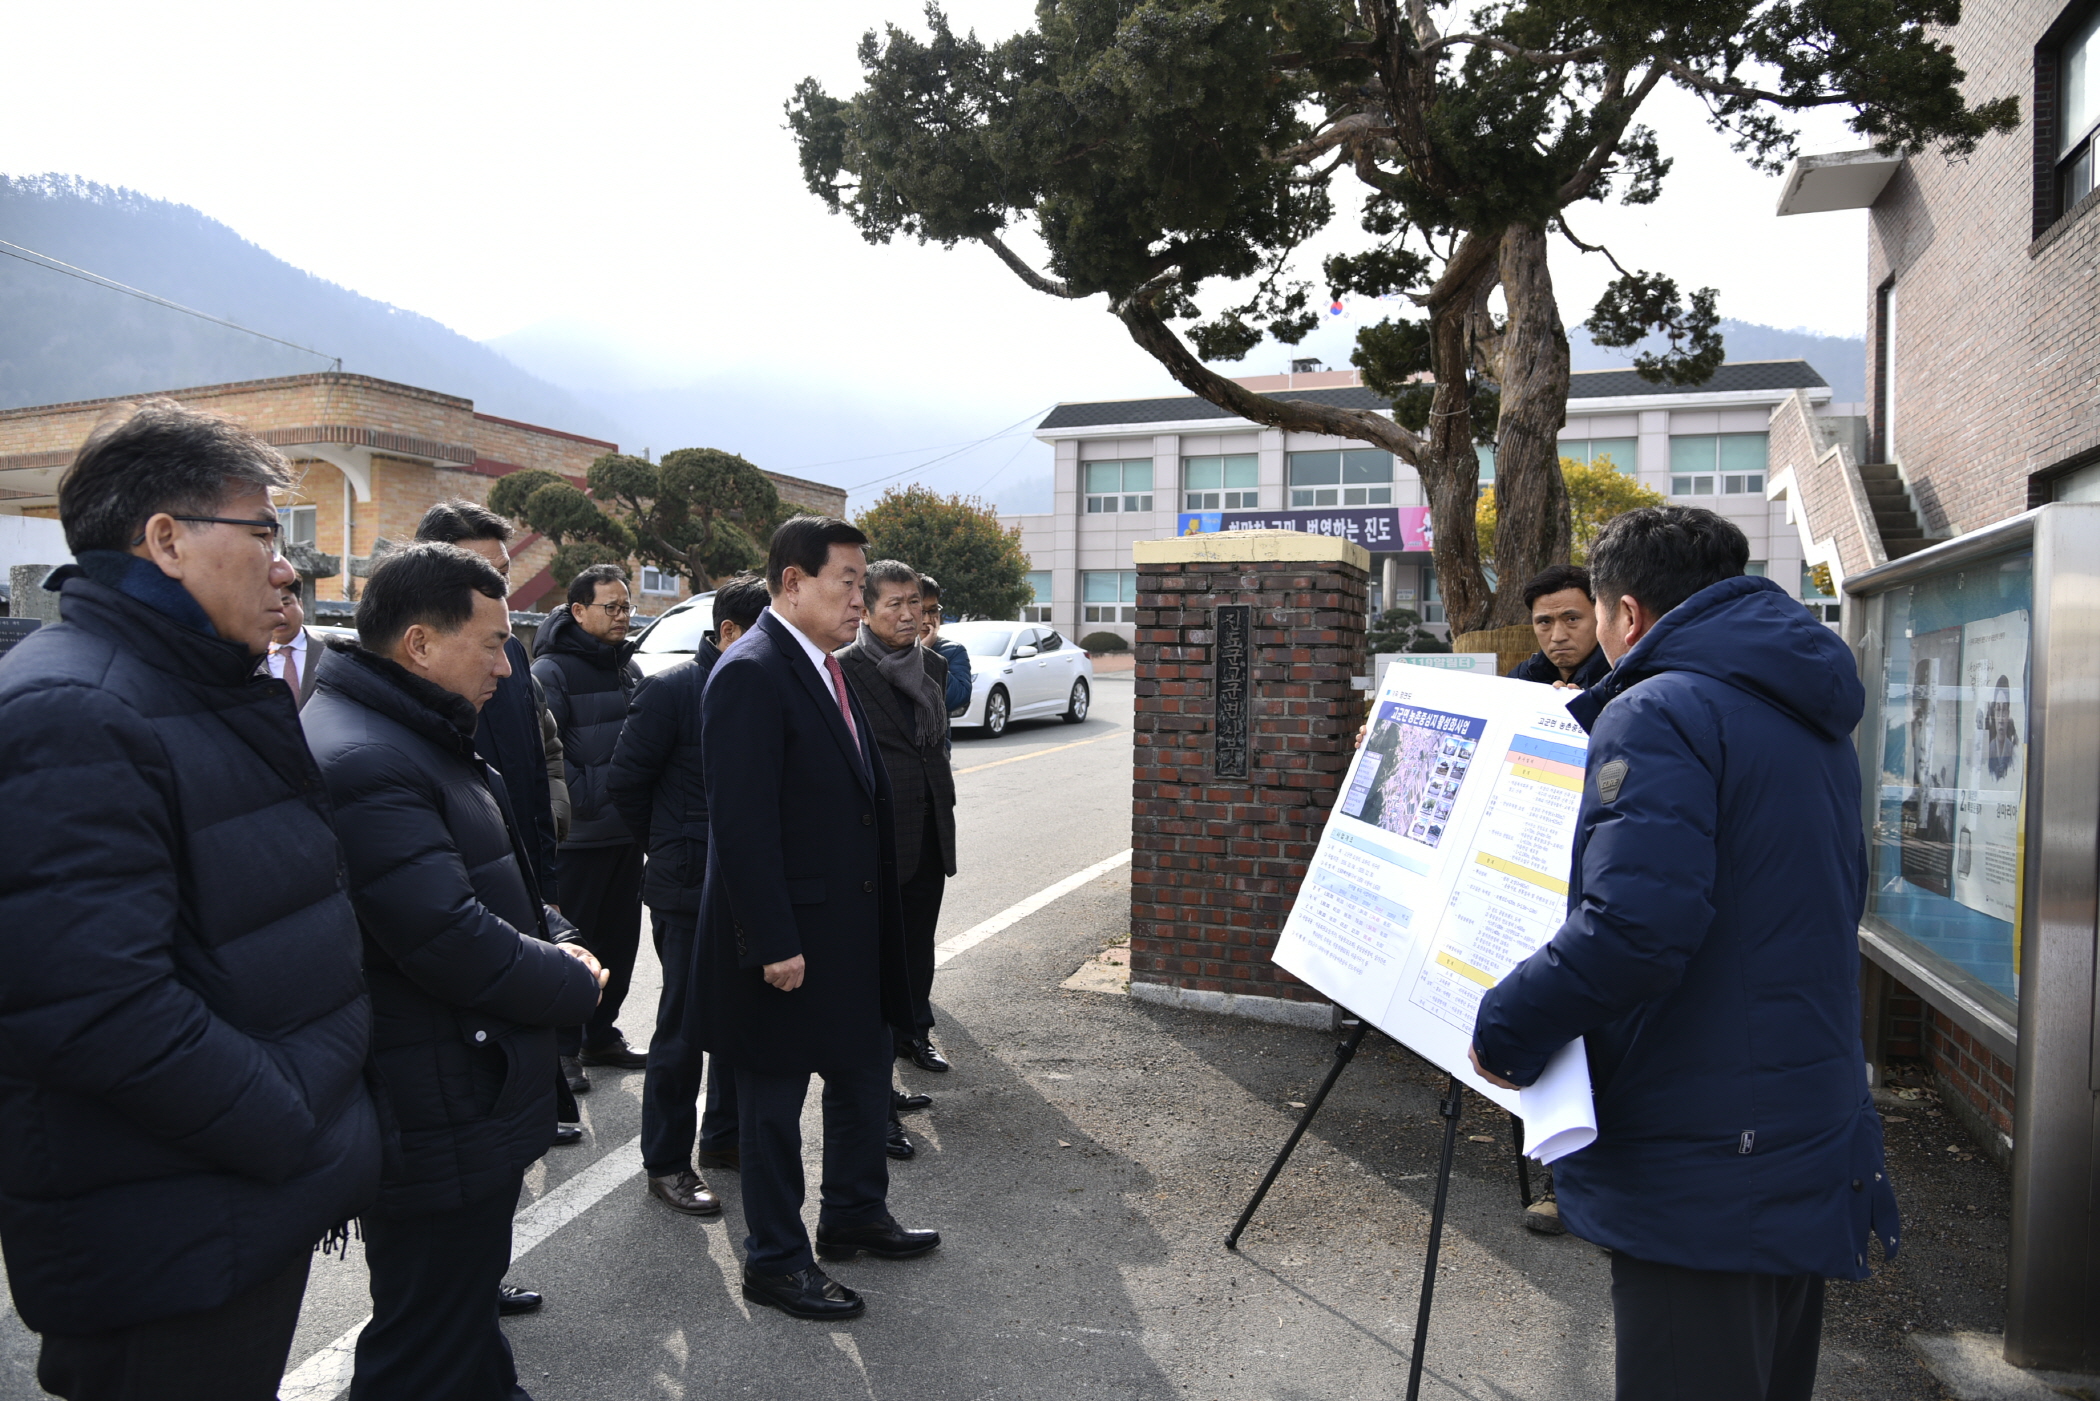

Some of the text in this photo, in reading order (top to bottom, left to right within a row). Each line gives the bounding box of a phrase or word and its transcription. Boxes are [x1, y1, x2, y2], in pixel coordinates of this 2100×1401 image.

[1306, 517, 1358, 543] 번영하는
[1364, 516, 1391, 543] 진도
[1390, 706, 1471, 735] 고군면 농촌중심지 활성화사업
[1996, 802, 2018, 821] 김마리아
